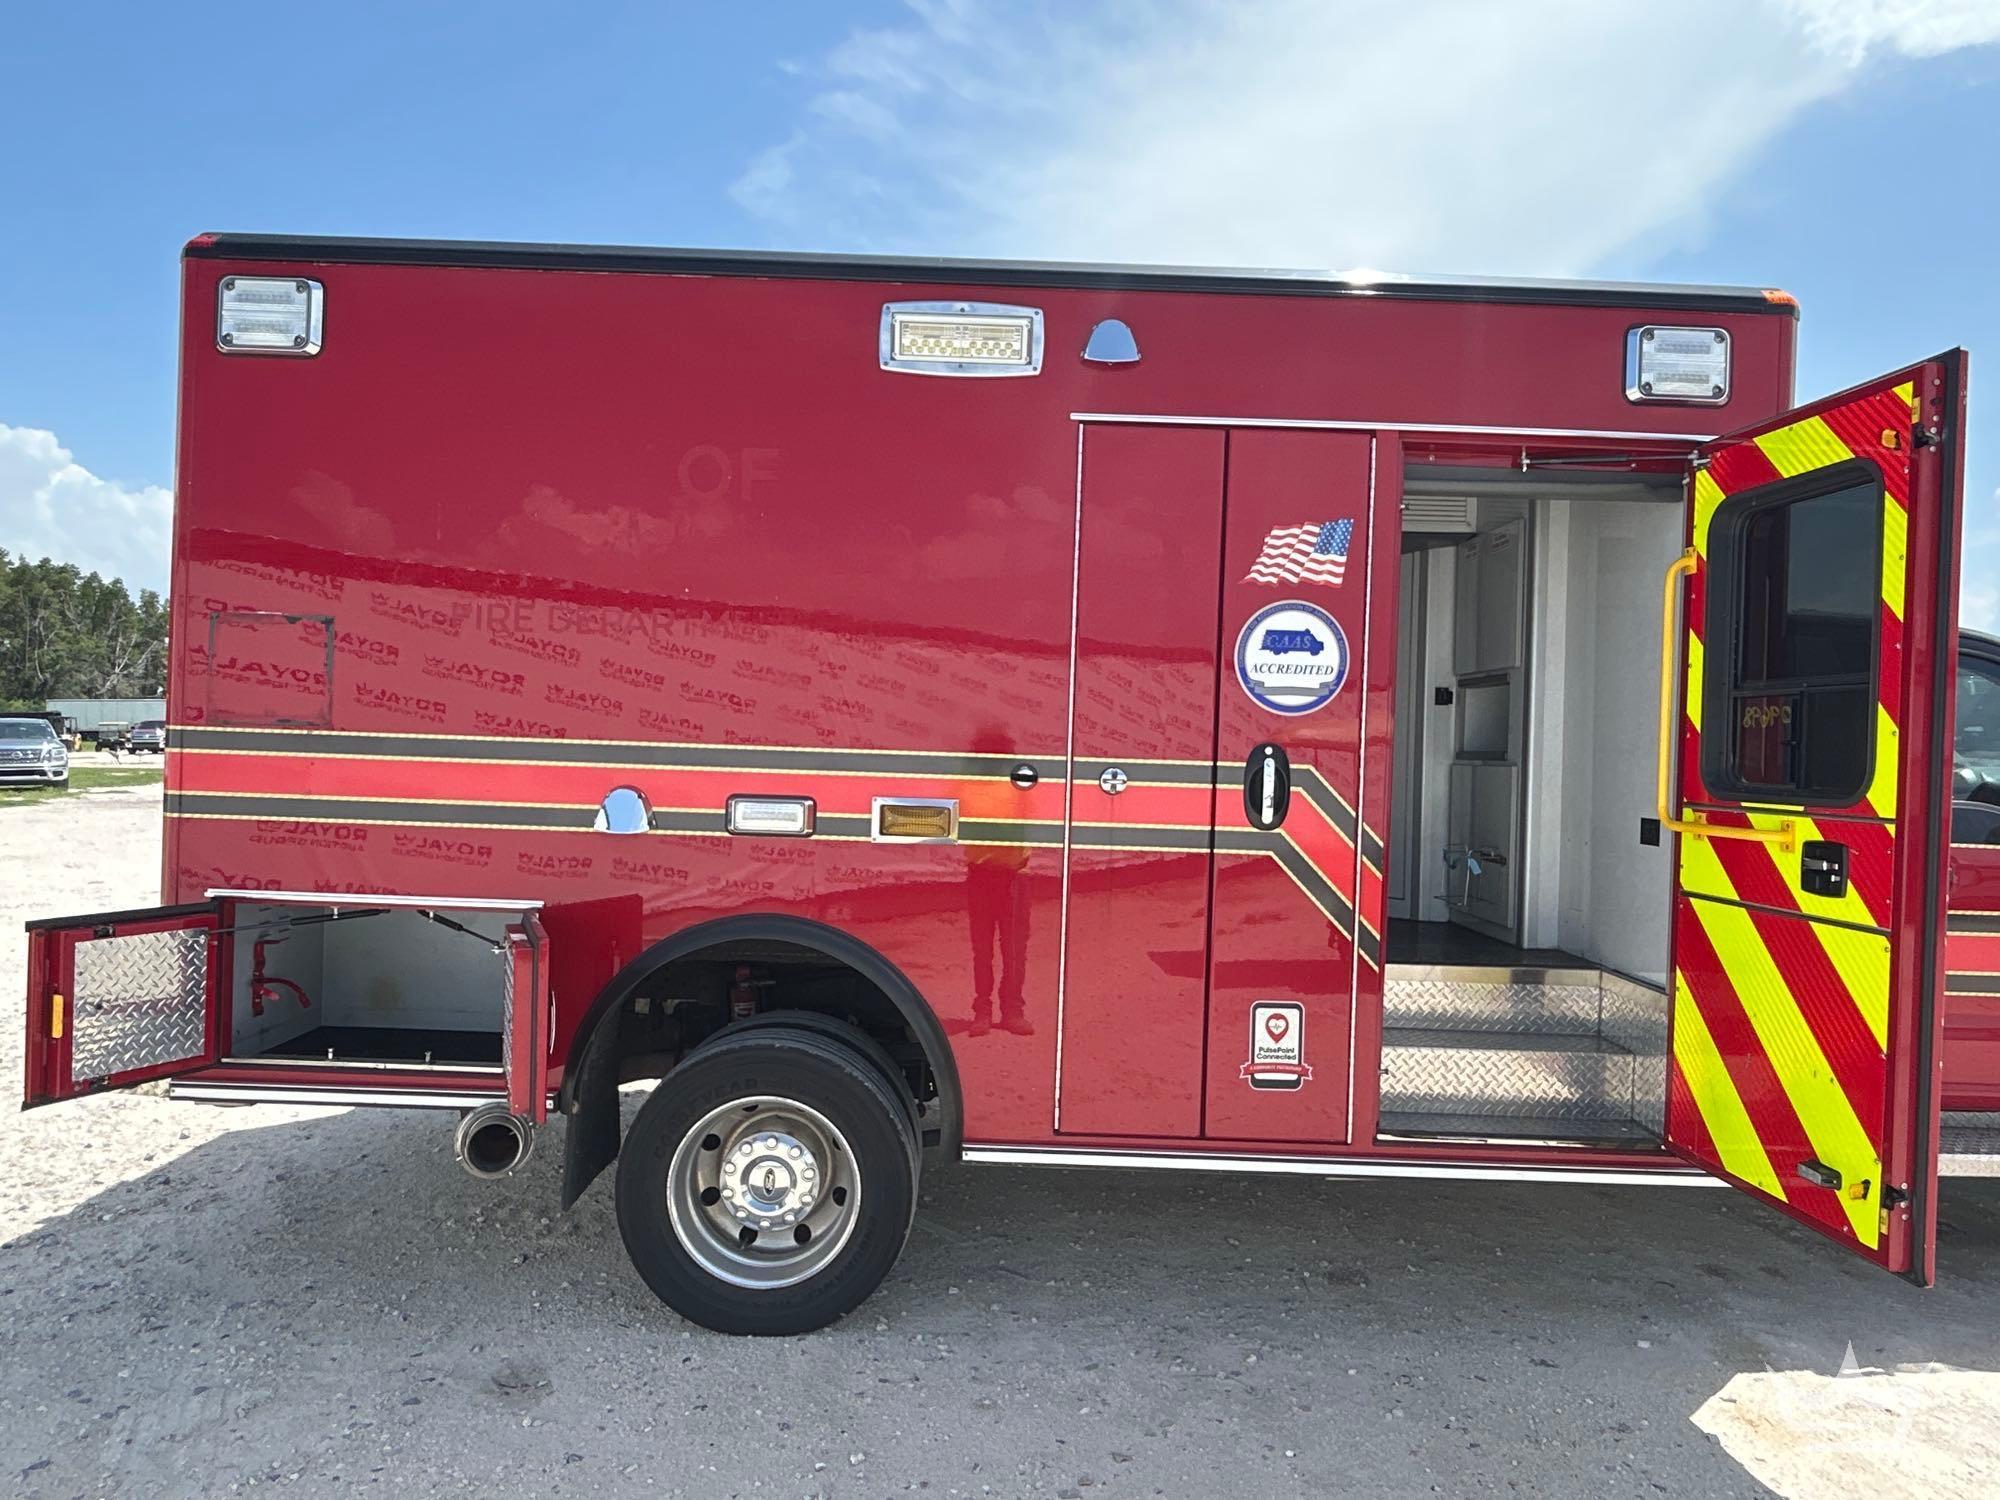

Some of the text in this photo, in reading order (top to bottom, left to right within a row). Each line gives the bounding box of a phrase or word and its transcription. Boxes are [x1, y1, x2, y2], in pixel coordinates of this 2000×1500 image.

[678, 444, 783, 502] OF
[451, 599, 535, 634] FIRE
[1265, 635, 1312, 649] CAAS
[1250, 663, 1334, 676] ACCREDITED
[1259, 1046, 1295, 1054] PulsePoint
[1256, 1053, 1297, 1061] Connected
